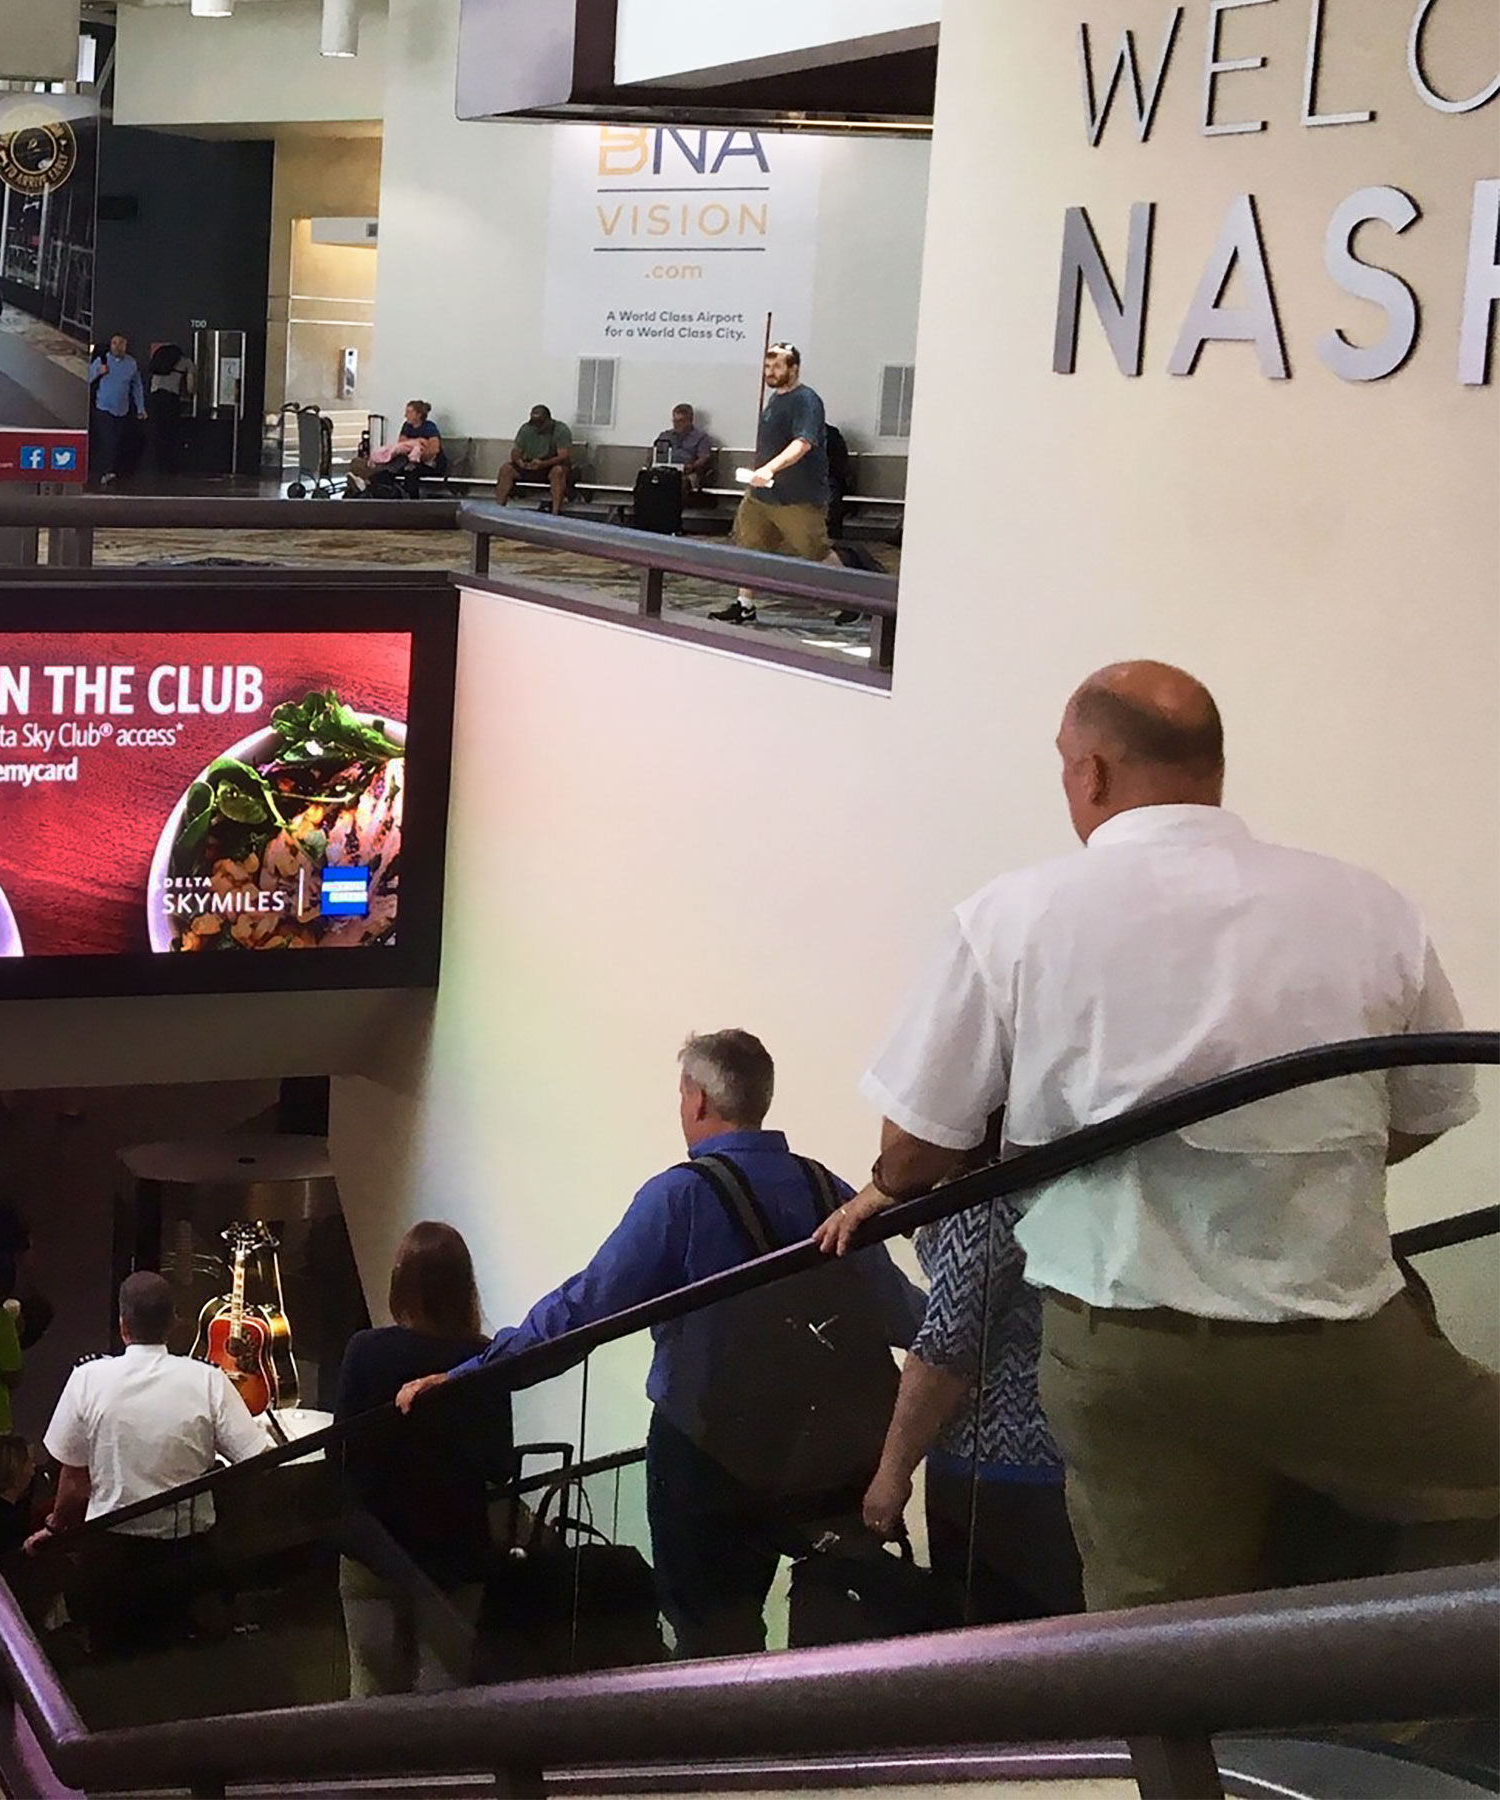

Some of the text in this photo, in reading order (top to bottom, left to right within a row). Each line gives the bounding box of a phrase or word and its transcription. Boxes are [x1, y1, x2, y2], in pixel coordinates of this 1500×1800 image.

[598, 123, 771, 176] BNA
[597, 203, 768, 236] VISION
[644, 262, 703, 279] .com
[606, 311, 744, 325] A World Class Airport
[605, 326, 746, 341] for a World Class City.
[44, 665, 136, 715] THE
[148, 664, 264, 714] CLUB
[22, 721, 55, 752] Sky
[163, 876, 213, 888] DELTA
[162, 891, 285, 914] SKYMILES
